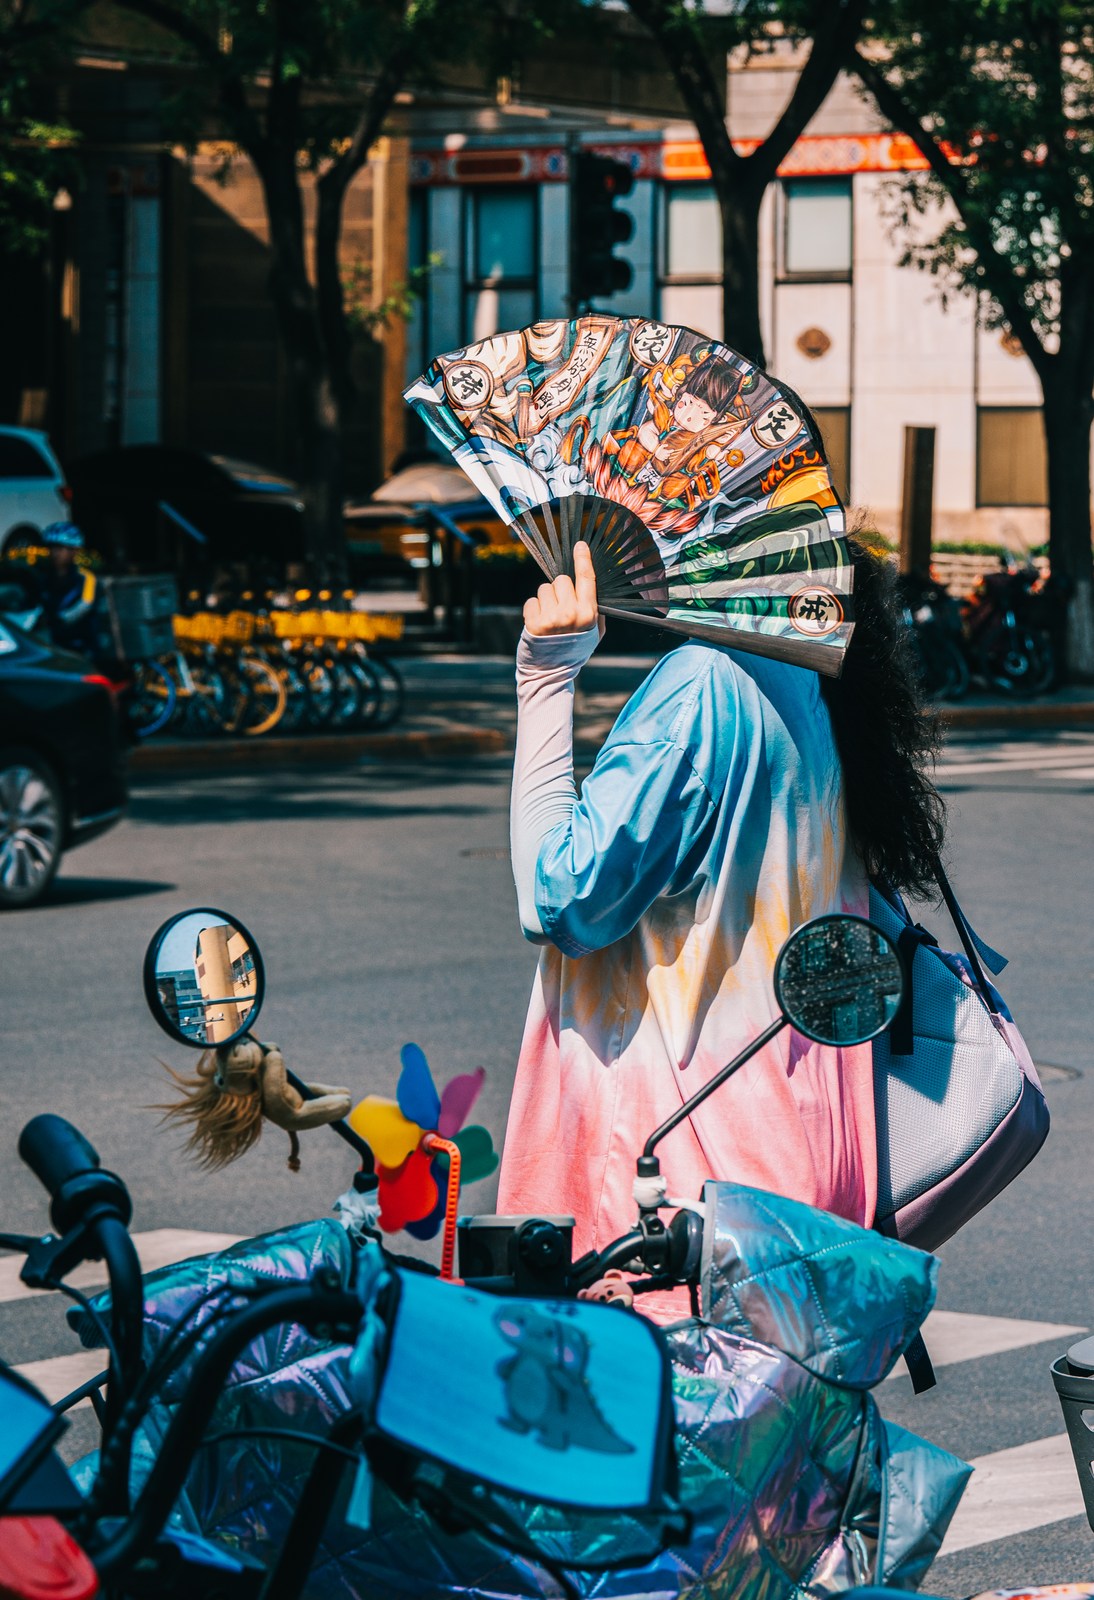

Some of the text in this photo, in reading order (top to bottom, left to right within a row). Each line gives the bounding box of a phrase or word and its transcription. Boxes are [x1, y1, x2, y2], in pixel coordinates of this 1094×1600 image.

[451, 370, 484, 400] 持
[757, 407, 795, 442] 定
[798, 595, 834, 630] 戒
